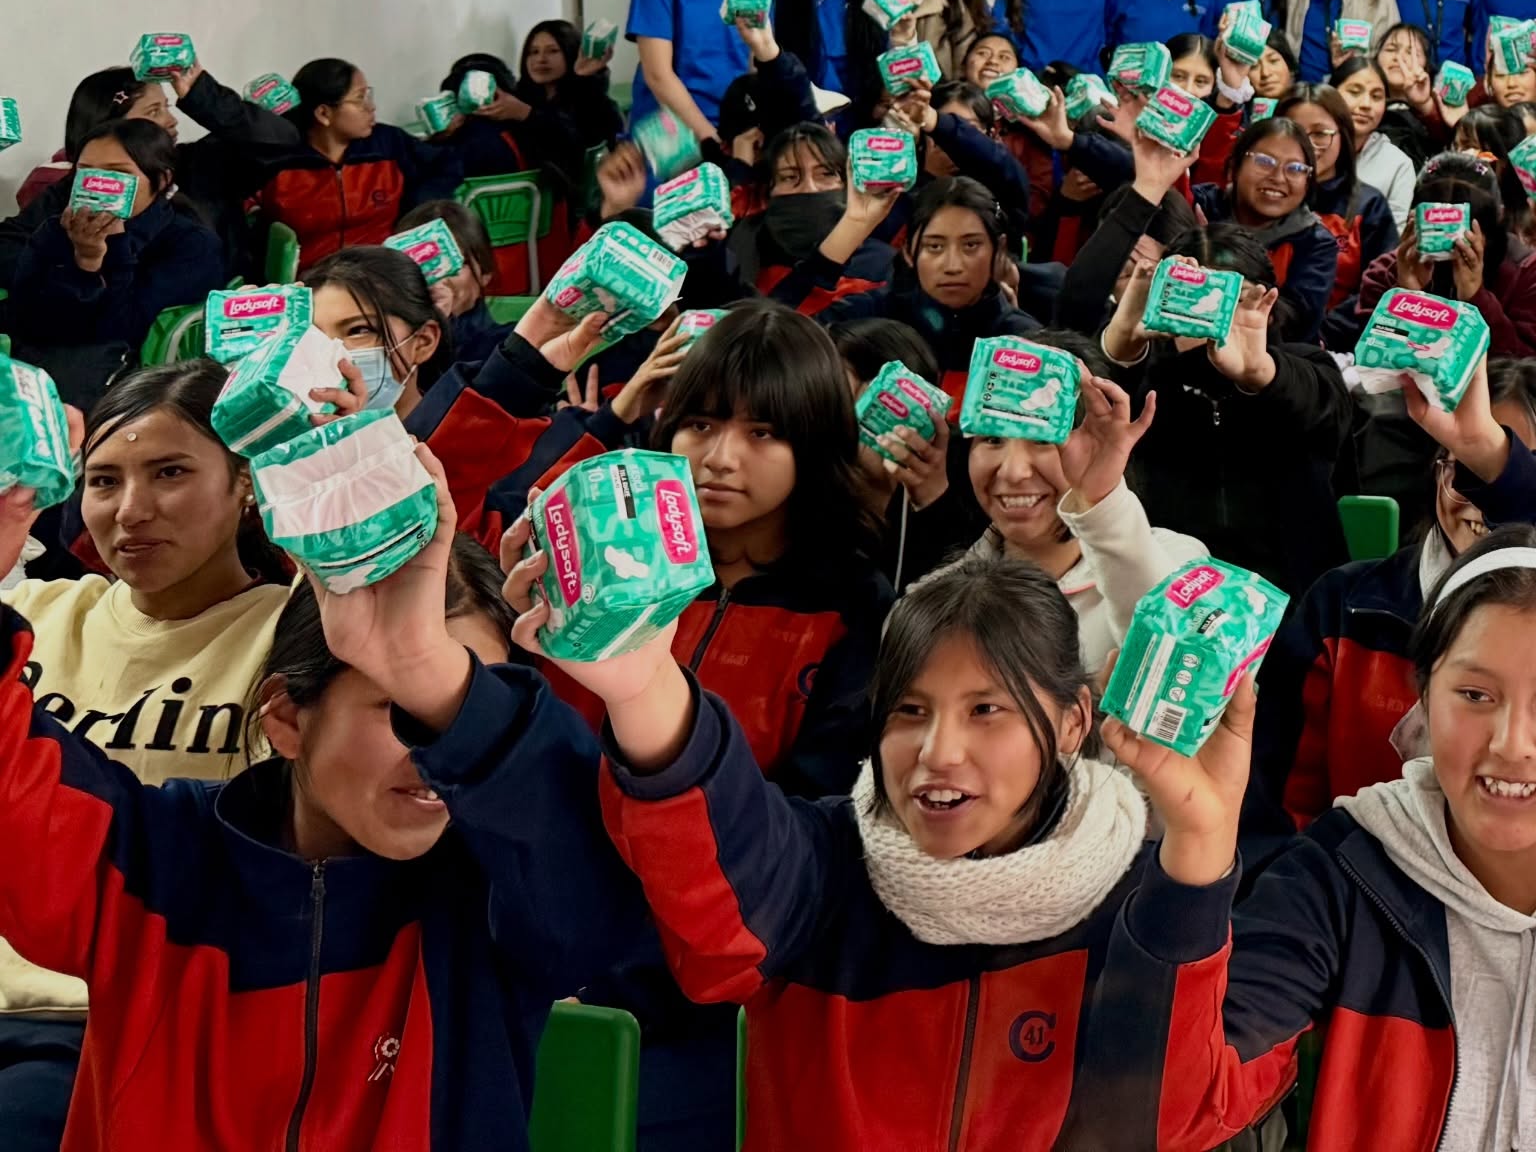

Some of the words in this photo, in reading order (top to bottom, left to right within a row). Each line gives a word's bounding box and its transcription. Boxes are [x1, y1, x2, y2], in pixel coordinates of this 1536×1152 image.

[229, 296, 279, 315] Ladysoft
[1392, 296, 1450, 322] Ladysoft
[998, 352, 1037, 368] Ladysoft
[659, 488, 692, 554] Ladysoft
[547, 502, 578, 592] Ladysoft
